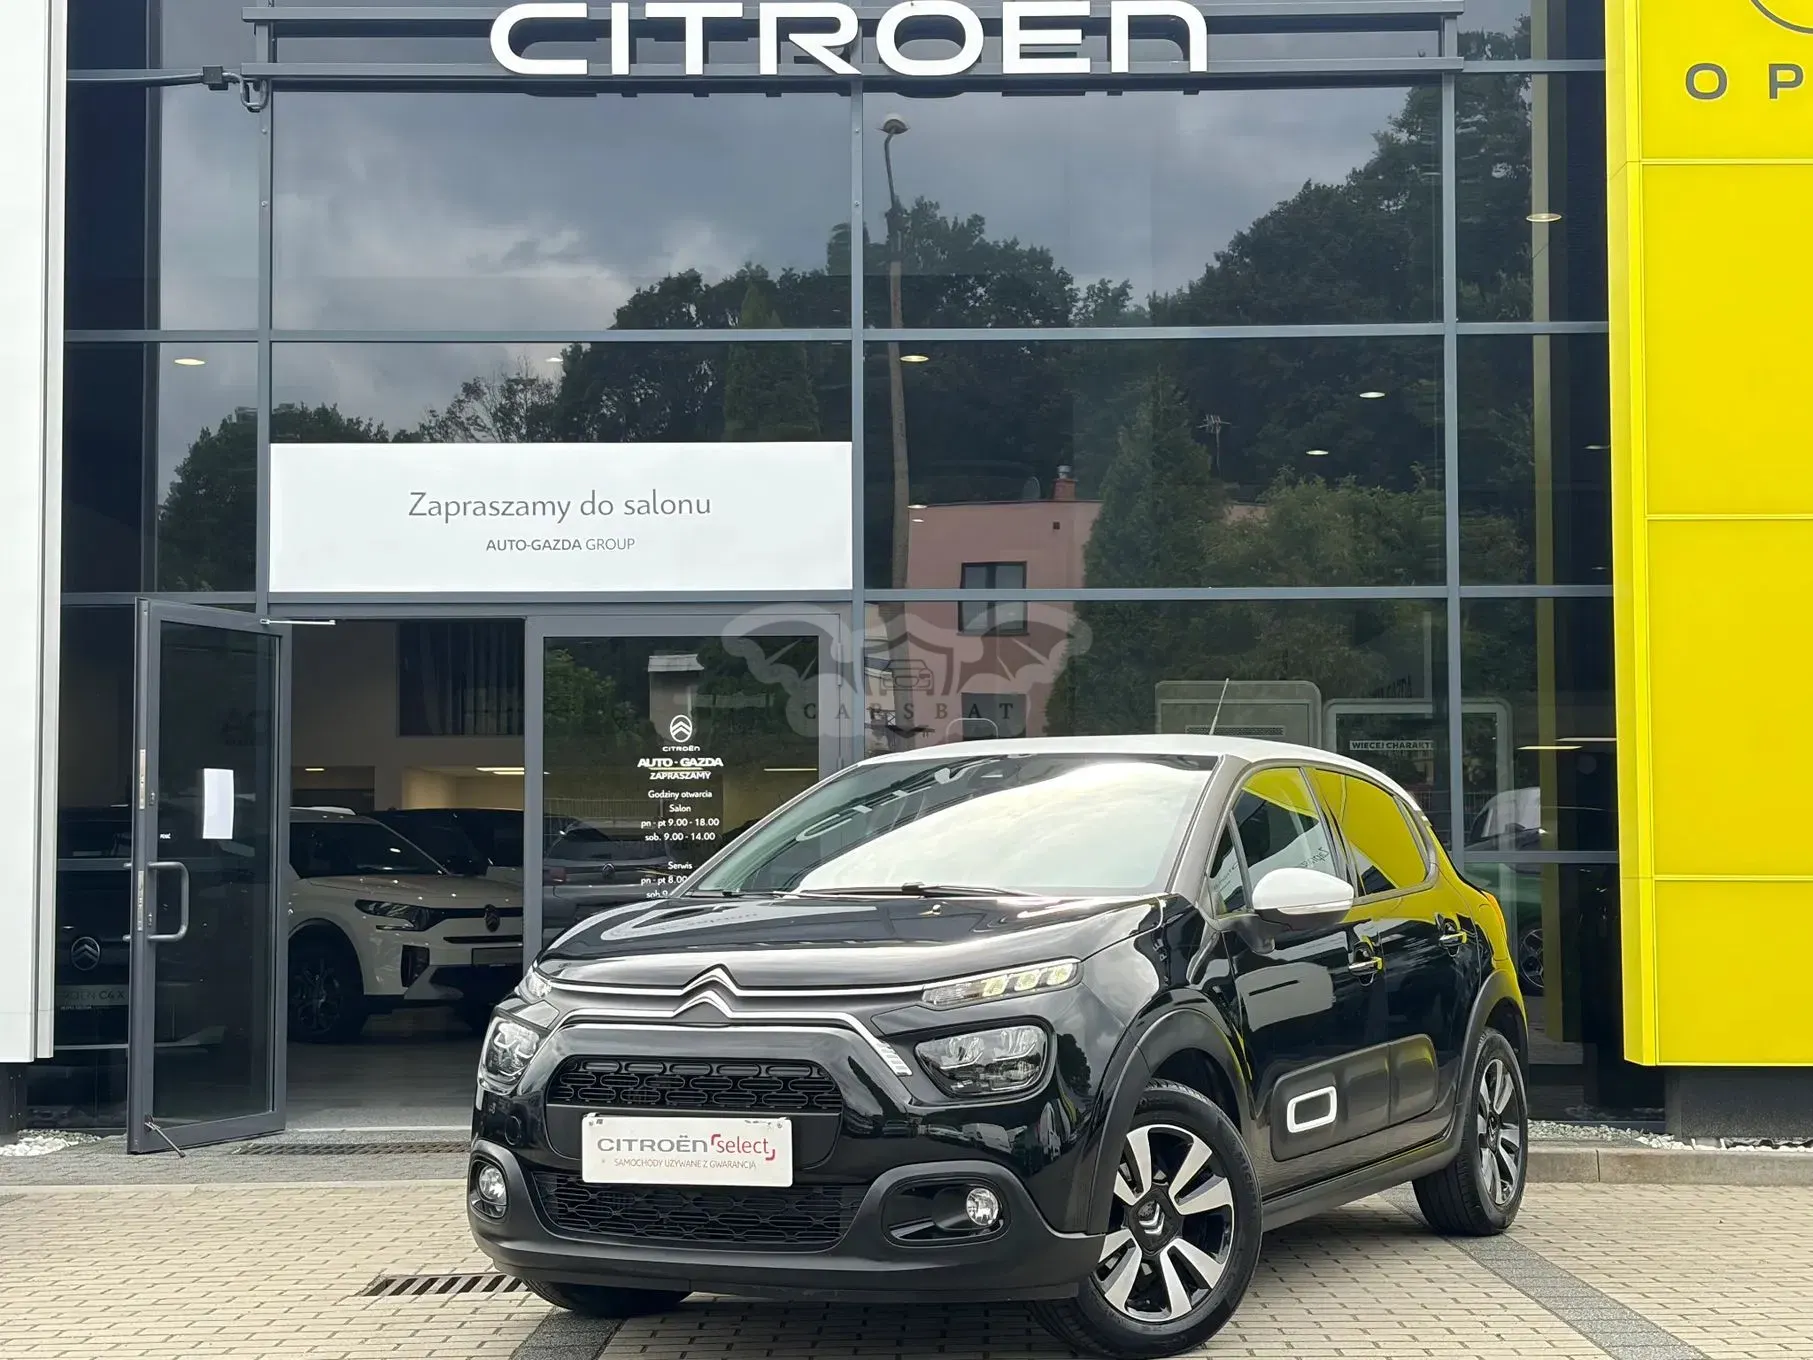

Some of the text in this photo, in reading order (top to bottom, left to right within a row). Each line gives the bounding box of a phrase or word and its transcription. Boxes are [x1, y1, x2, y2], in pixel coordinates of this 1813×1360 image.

[408, 488, 711, 524] Zapraszamy do salonu
[486, 538, 635, 551] AUTO-GAZDA GROUP
[649, 771, 712, 780] ZAPRASZAMY
[648, 789, 713, 800] Godziny otwarcia
[669, 804, 692, 813] Salon
[640, 820, 652, 829] pn
[658, 820, 667, 829] pt
[667, 818, 688, 827] 9.00
[695, 818, 720, 827] 18.00
[645, 833, 662, 841] sob.
[663, 832, 684, 841] 9.00
[691, 832, 716, 841] 14.00
[668, 861, 693, 870] Serwis
[640, 877, 652, 886] pn
[657, 877, 667, 886] pt
[597, 1134, 770, 1154] CITROËN select
[614, 1158, 663, 1167] SAMOCHODY
